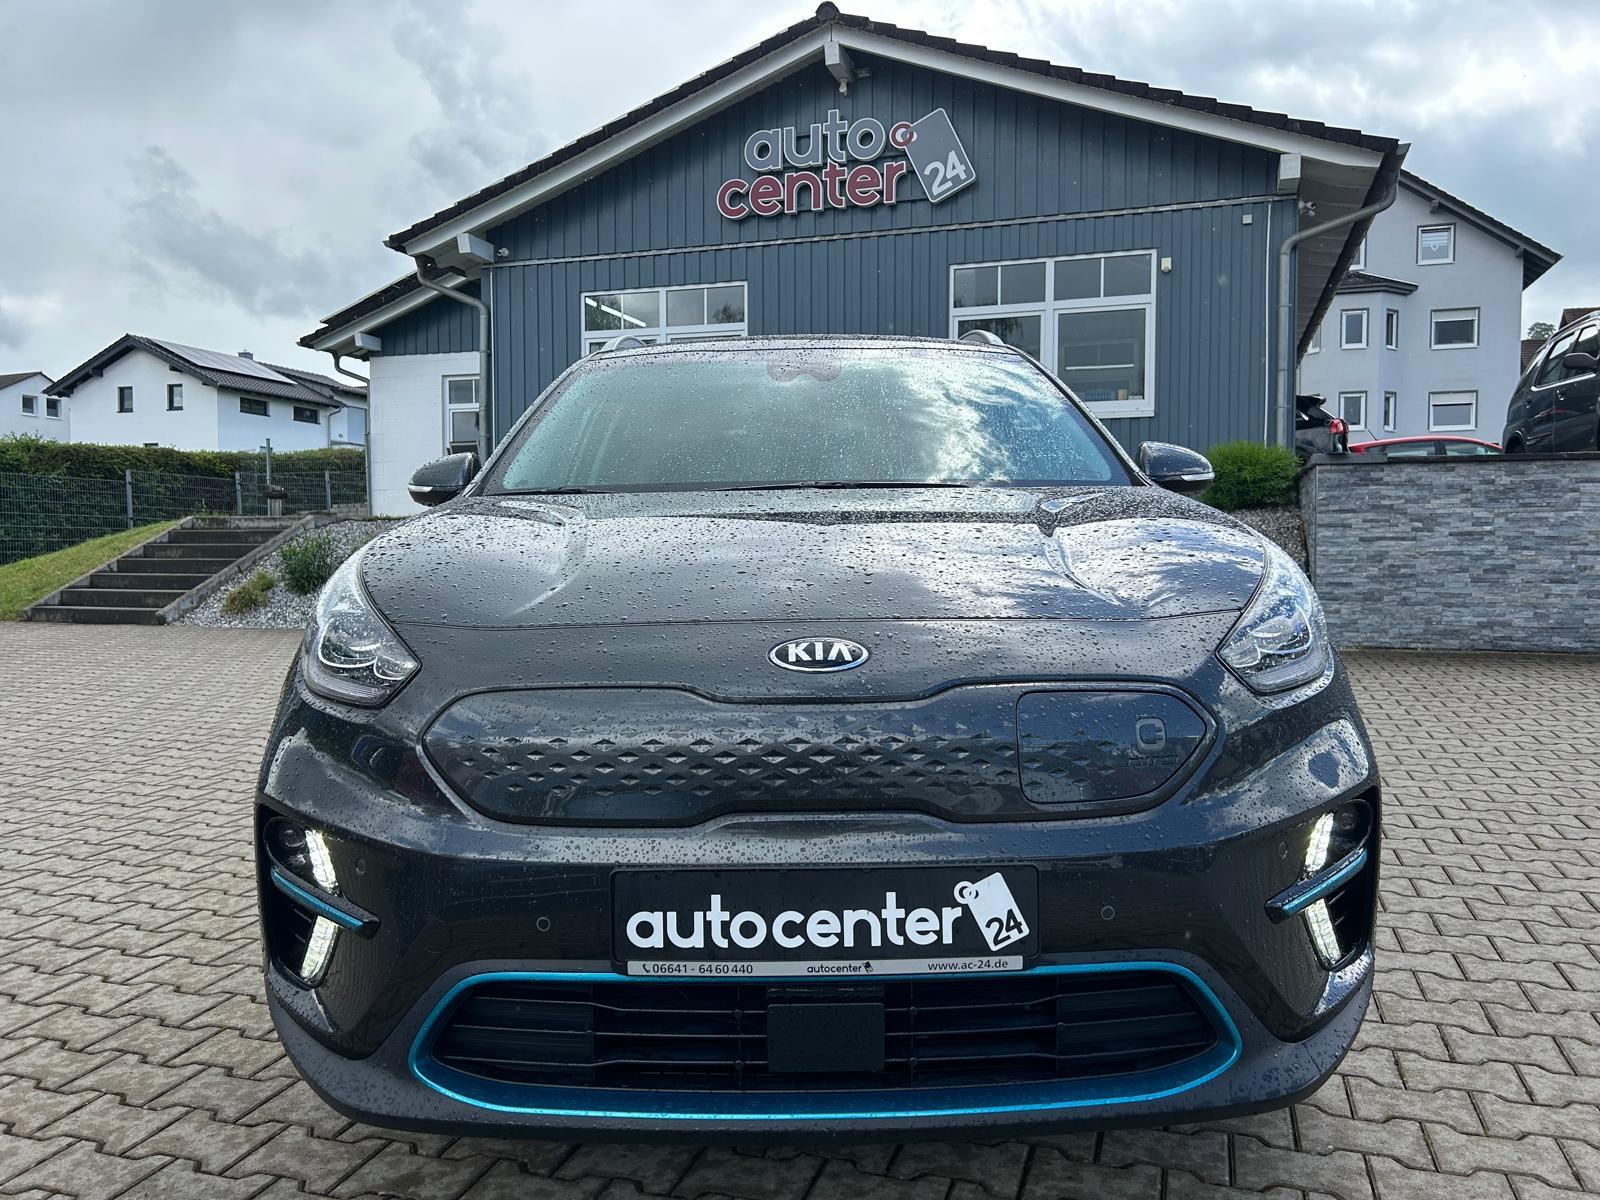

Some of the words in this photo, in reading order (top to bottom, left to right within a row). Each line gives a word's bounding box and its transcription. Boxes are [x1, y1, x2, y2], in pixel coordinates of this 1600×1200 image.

[744, 108, 887, 172] auto
[716, 157, 907, 220] center
[923, 150, 967, 197] 24
[787, 641, 853, 662] KIA
[985, 908, 1024, 947] 24
[652, 963, 688, 974] 06641
[806, 963, 862, 973] autocenter
[927, 958, 1009, 971] www.ac-24.de
